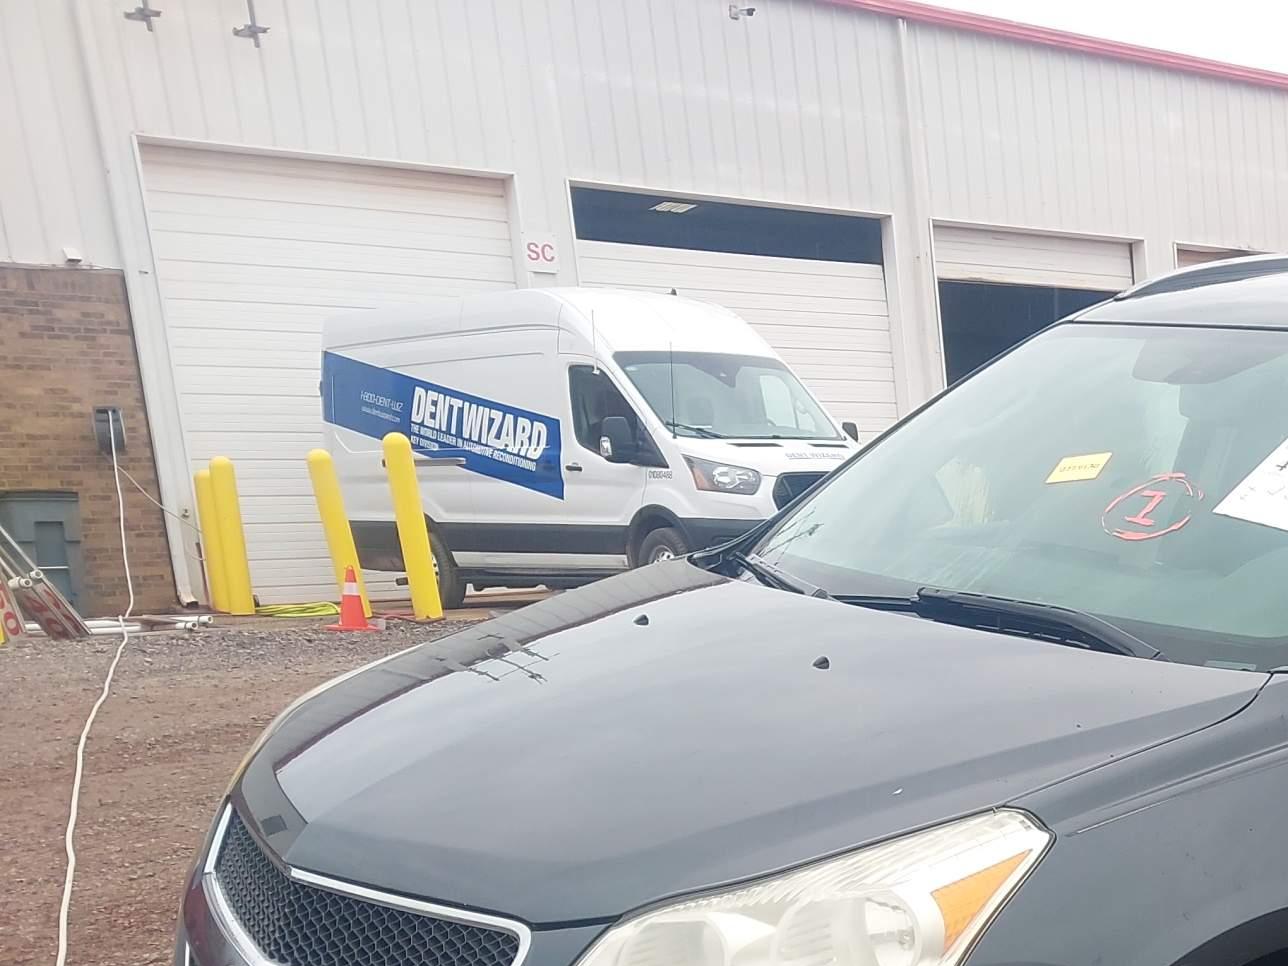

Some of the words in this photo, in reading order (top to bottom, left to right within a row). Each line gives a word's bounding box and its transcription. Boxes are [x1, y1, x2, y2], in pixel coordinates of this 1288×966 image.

[527, 242, 555, 262] SC
[410, 386, 463, 434] DENT
[462, 401, 548, 460] WIZARD
[410, 423, 420, 434] THE
[420, 426, 437, 439] WORLD
[437, 431, 456, 446] LEADER
[463, 440, 493, 458] AUTOMOTIVE
[493, 449, 537, 471] RECONDITIONING
